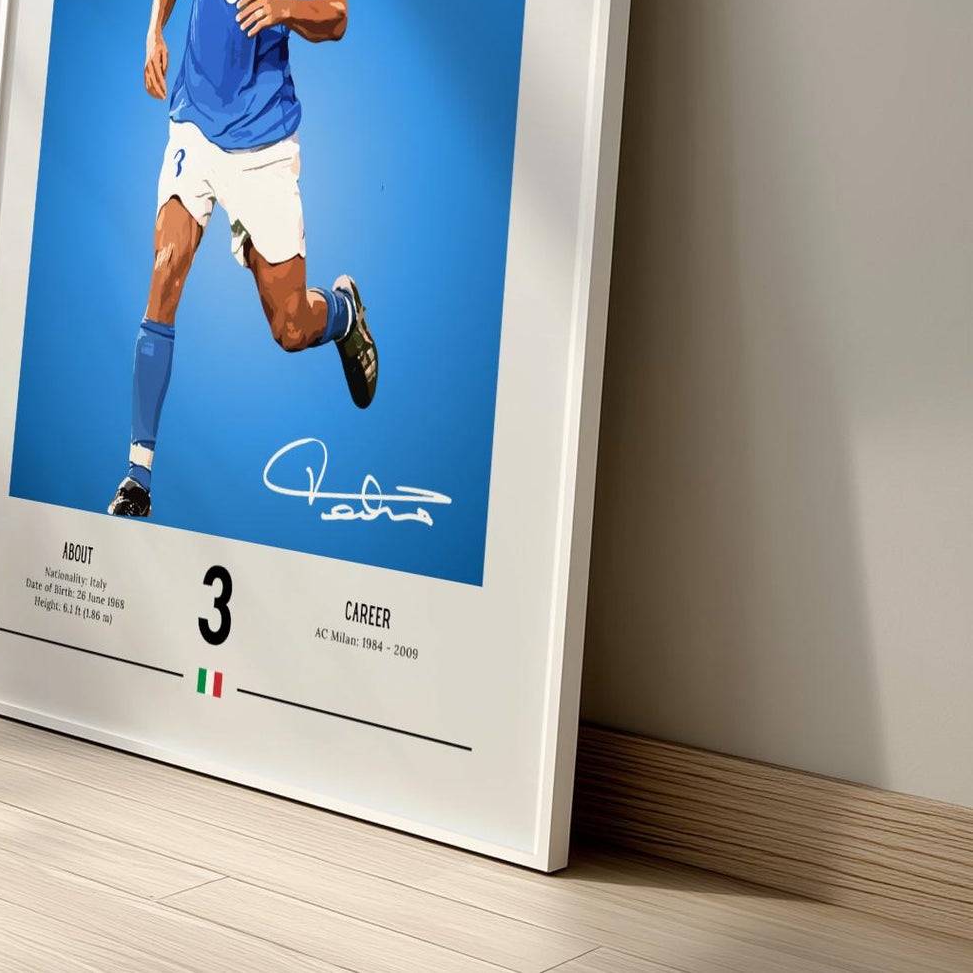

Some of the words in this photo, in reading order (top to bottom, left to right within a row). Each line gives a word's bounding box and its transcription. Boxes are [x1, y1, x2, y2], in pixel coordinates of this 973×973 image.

[62, 541, 94, 565] ABOUT
[26, 578, 43, 590] Date
[44, 583, 53, 592] of
[54, 585, 75, 598] Birth:
[77, 590, 86, 600] 26
[88, 592, 105, 605] June
[107, 597, 125, 610] 1968
[45, 567, 88, 587] Nationality:
[90, 577, 108, 592] Italy
[63, 603, 73, 614] 6.1
[74, 605, 82, 616] ft
[83, 608, 101, 621] (1.86
[102, 613, 113, 626] m)
[198, 564, 233, 646] 3
[345, 600, 391, 629] CAREER
[315, 627, 328, 640] AC
[330, 630, 360, 647] Milan:
[362, 637, 383, 652] 1984
[393, 644, 419, 660] 2009
